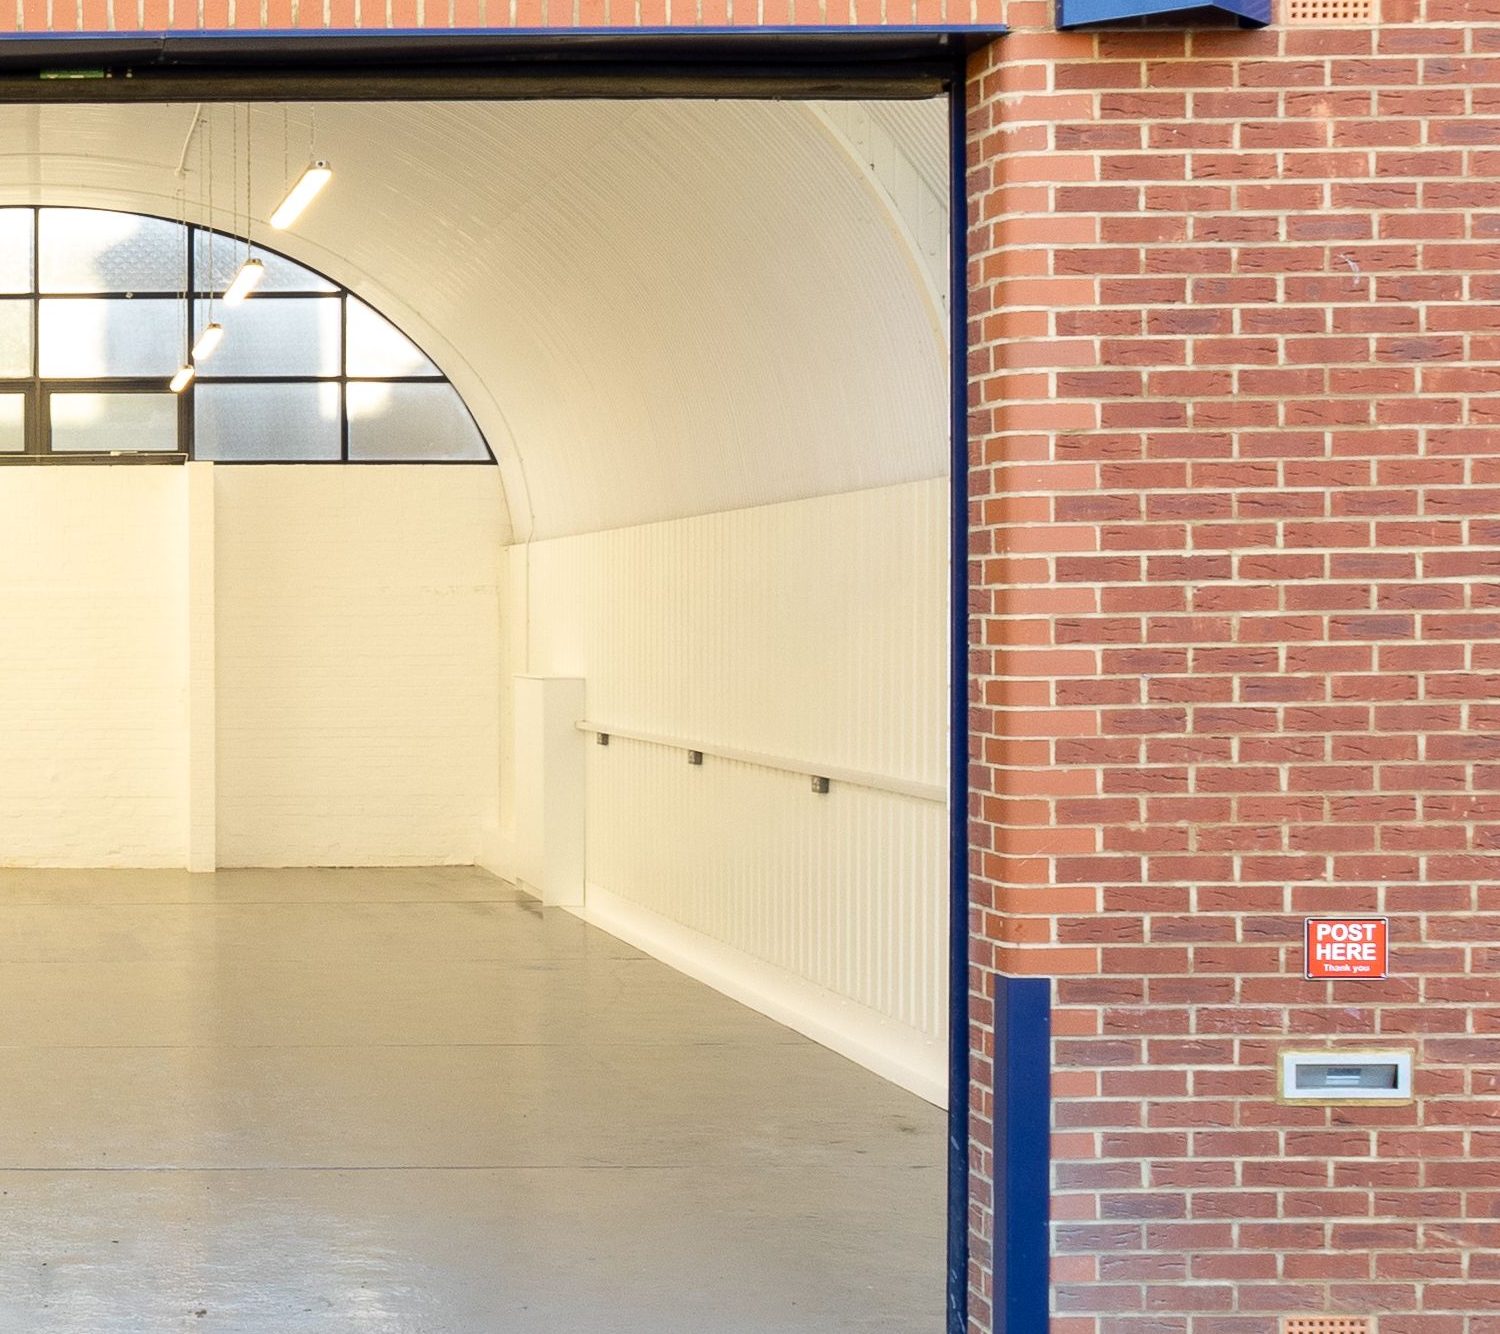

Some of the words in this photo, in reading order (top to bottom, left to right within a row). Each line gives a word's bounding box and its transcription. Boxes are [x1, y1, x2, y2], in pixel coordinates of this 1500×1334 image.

[1316, 923, 1377, 941] POST
[1316, 942, 1377, 960] HERE
[1323, 963, 1351, 972] Thank
[1352, 965, 1370, 973] you
